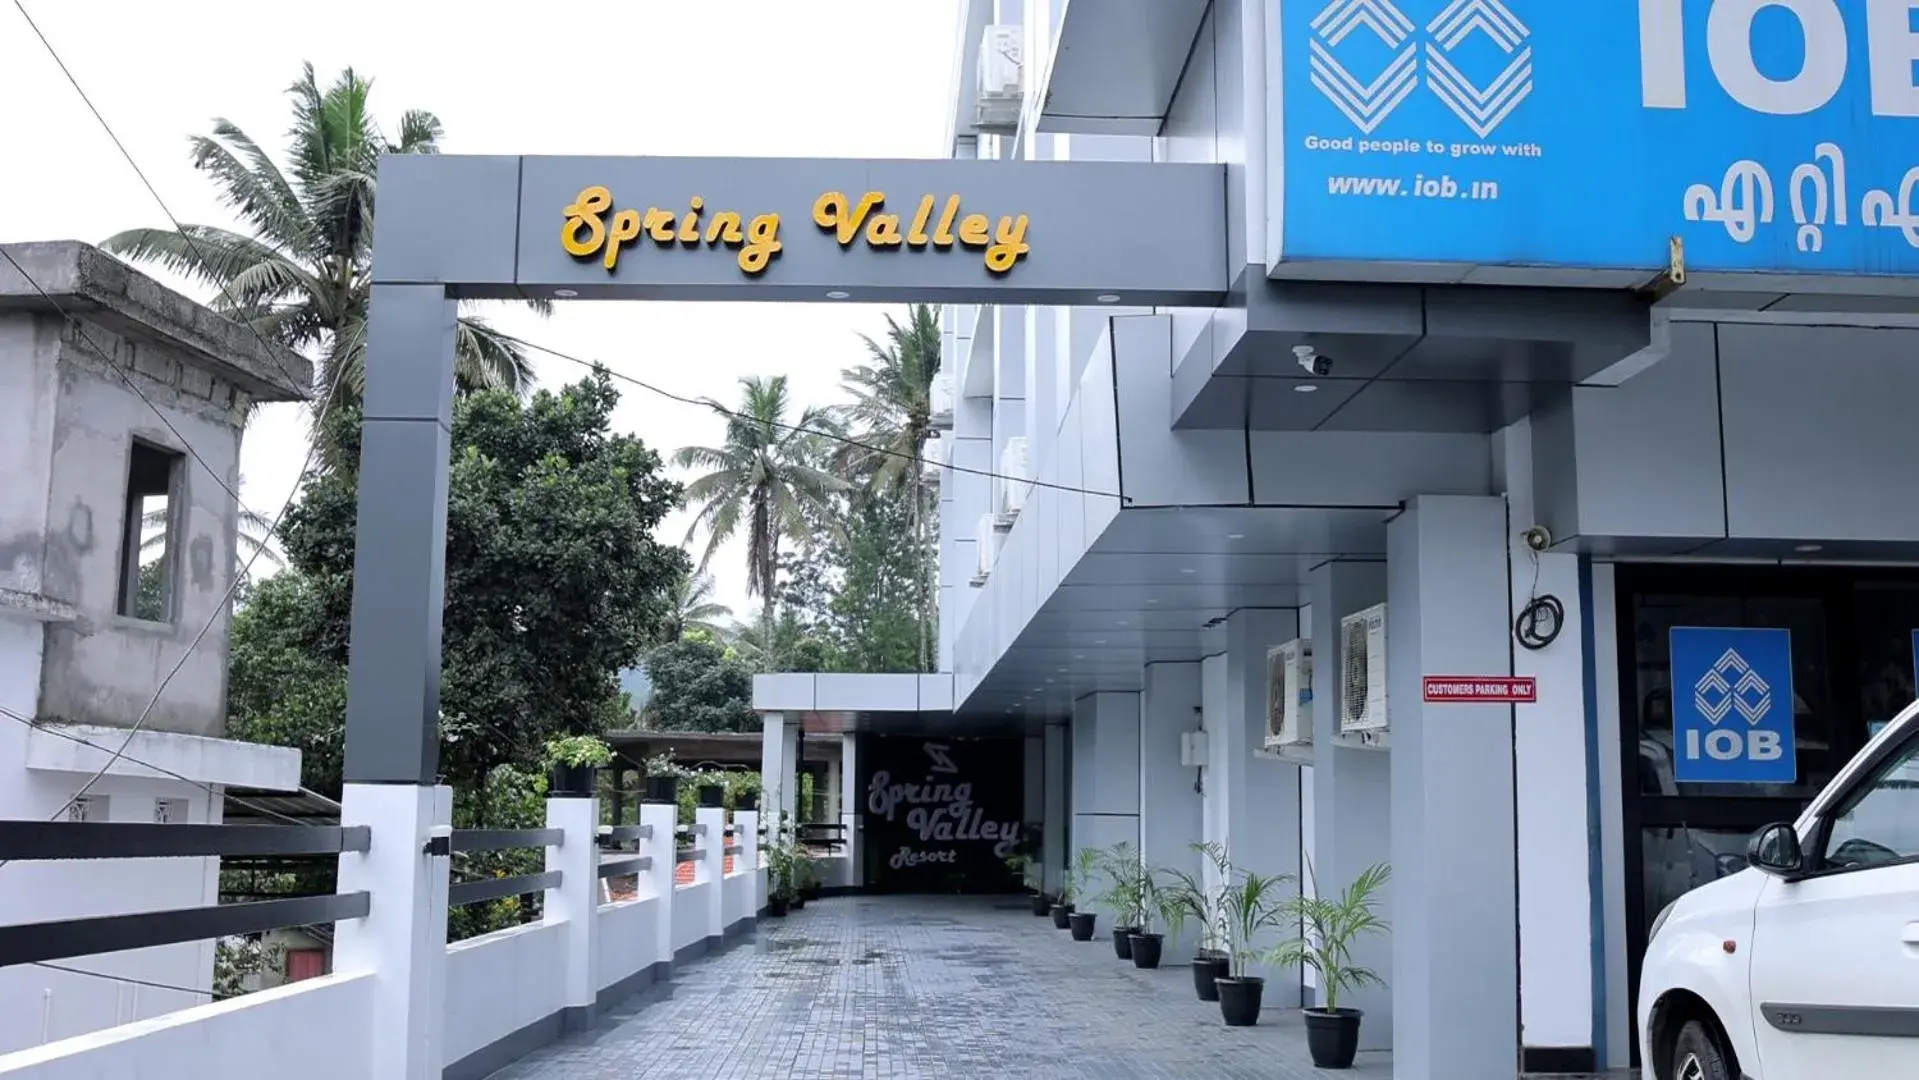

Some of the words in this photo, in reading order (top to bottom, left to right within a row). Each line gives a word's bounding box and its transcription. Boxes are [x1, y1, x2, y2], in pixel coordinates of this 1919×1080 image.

[1304, 135, 1353, 150] Good
[1358, 138, 1421, 154] people
[1426, 139, 1445, 153] to
[1450, 142, 1498, 158] grow
[1502, 142, 1543, 157] with
[561, 186, 782, 273] Spring
[813, 191, 1030, 273] Valley
[1427, 683, 1474, 695] CUSTOMERS
[1475, 683, 1508, 695] PARKING
[1511, 684, 1532, 695] ONLY
[1686, 729, 1783, 761] IOB
[868, 770, 974, 821] Spring
[906, 807, 1020, 858] Valley
[889, 846, 958, 869] Resort
